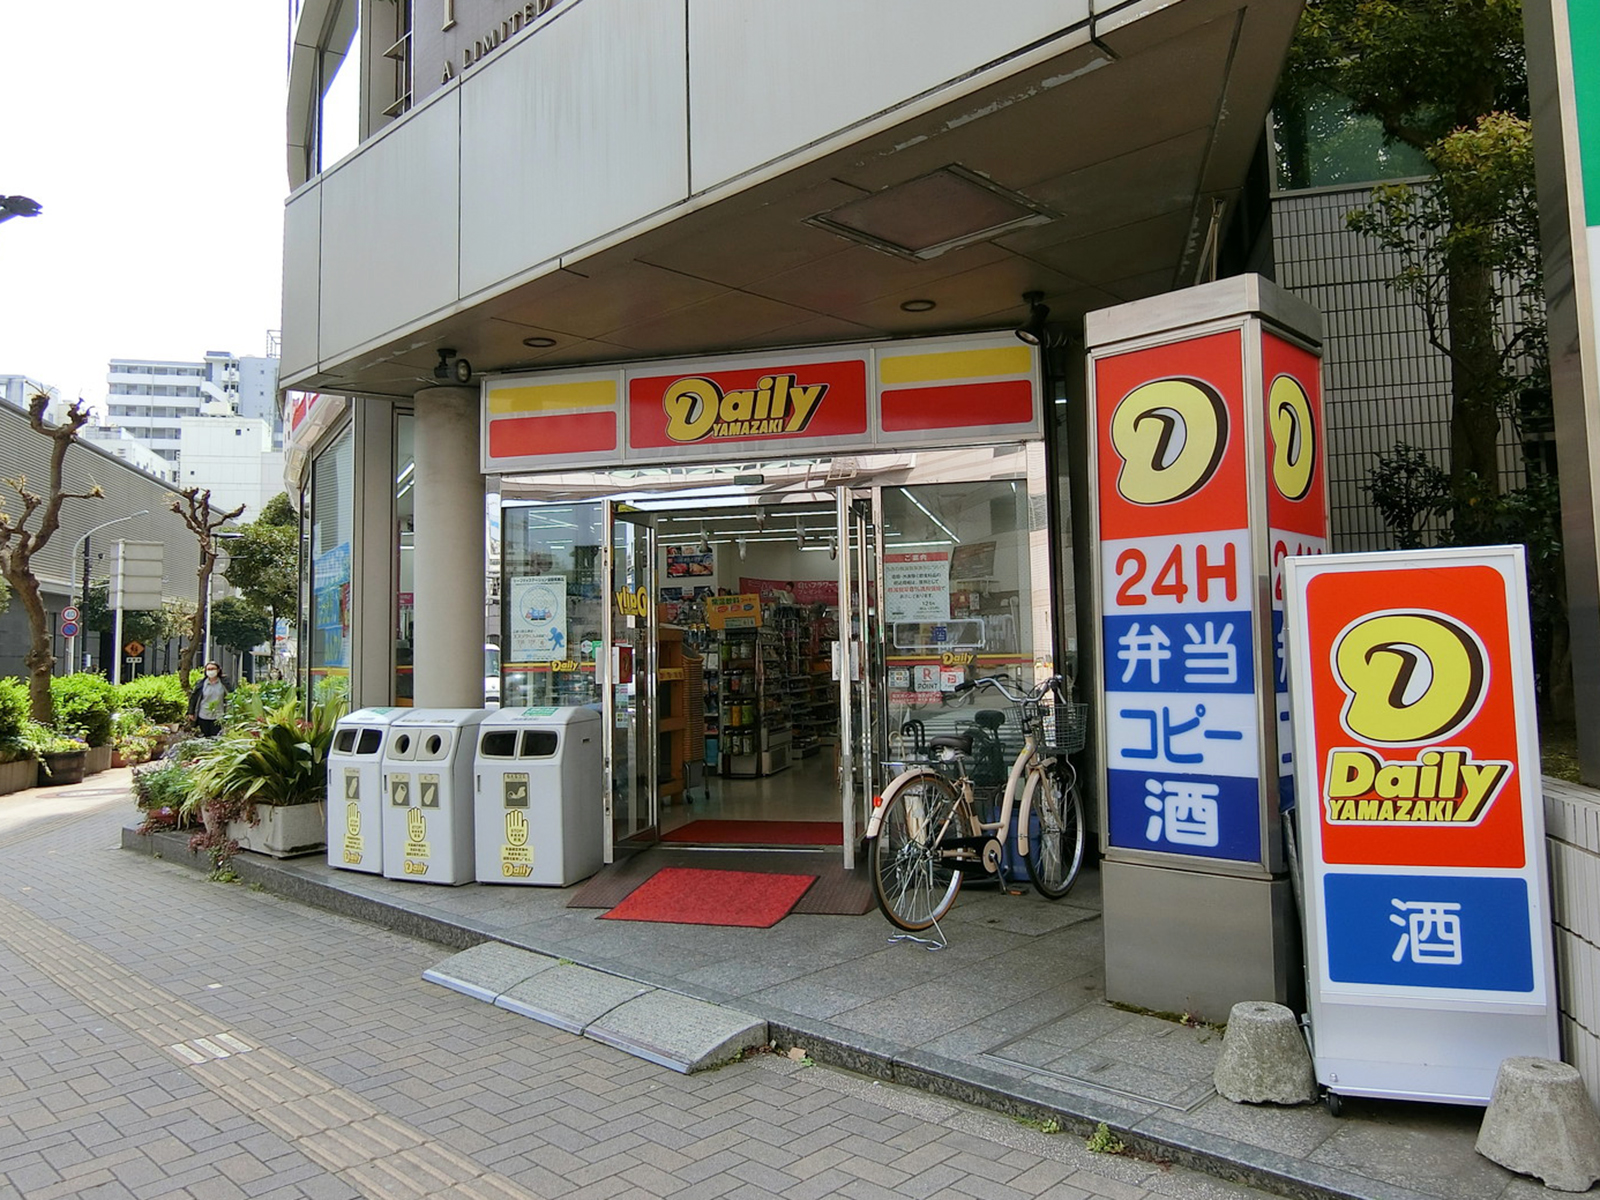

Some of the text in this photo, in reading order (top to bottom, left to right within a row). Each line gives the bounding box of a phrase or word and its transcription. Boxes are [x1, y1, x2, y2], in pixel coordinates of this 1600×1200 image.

[441, 59, 454, 85] A
[463, 0, 553, 69] LIMITED
[664, 373, 829, 443] Daily
[712, 419, 783, 438] YAMAZAKI
[1115, 541, 1238, 606] 24H
[550, 659, 580, 672] Daily
[942, 651, 976, 665] Daily
[1117, 620, 1238, 685] 弁当
[1119, 702, 1243, 764] コピー
[1143, 777, 1221, 848] 酒
[1328, 749, 1511, 824] Daily
[1329, 798, 1454, 823] YAMAZAKI
[403, 859, 428, 876] Daily
[501, 862, 534, 879] Daily
[1388, 897, 1463, 966] 酒
